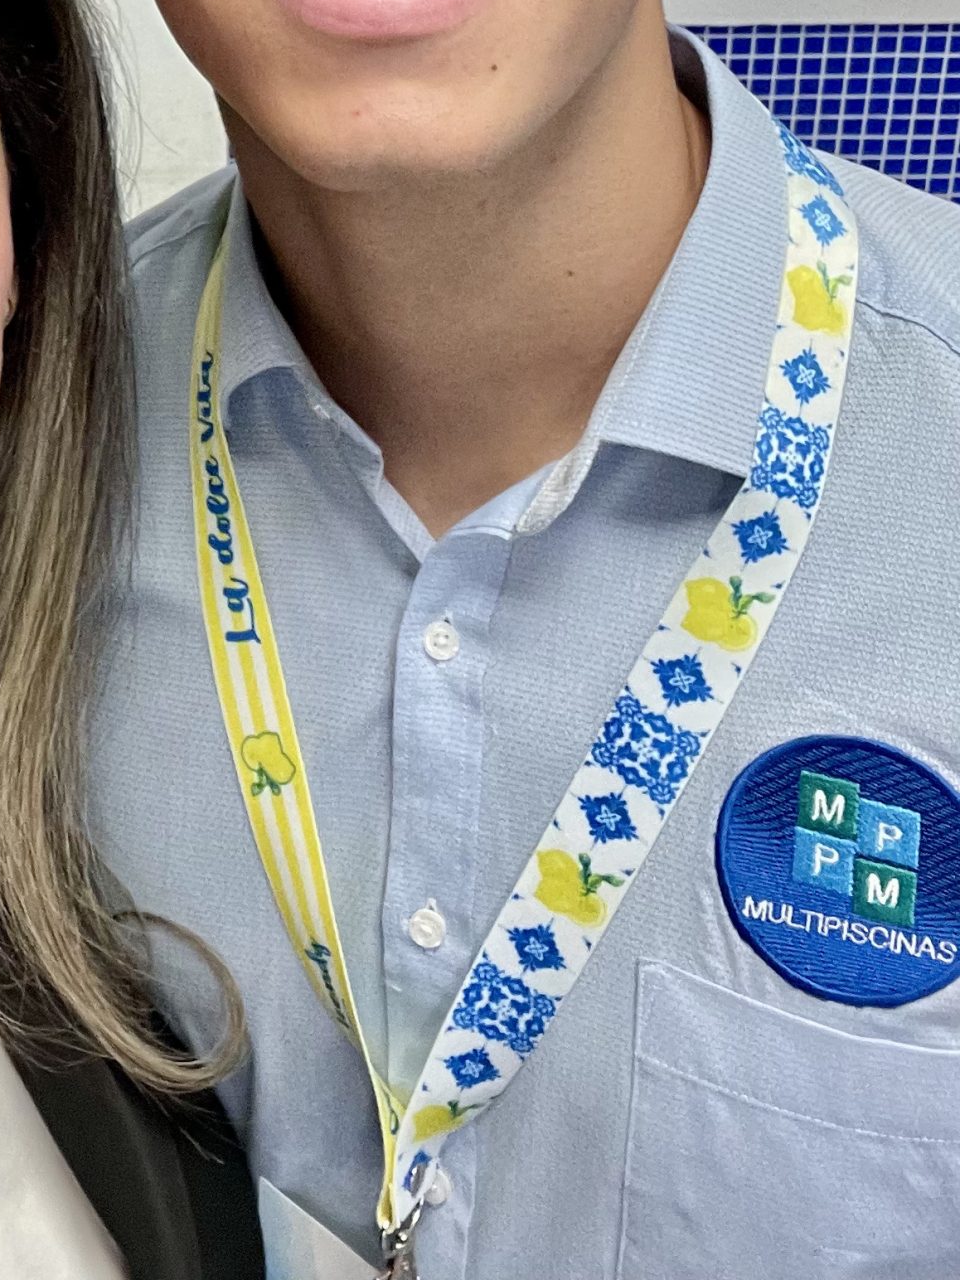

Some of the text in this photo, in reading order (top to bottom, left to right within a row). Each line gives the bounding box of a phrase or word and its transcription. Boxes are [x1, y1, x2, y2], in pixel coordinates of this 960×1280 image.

[206, 455, 234, 566] dolce
[222, 577, 262, 645] La
[811, 789, 903, 853] M P
[811, 843, 901, 909] P M
[742, 896, 958, 964] MULTIPISCINAS
